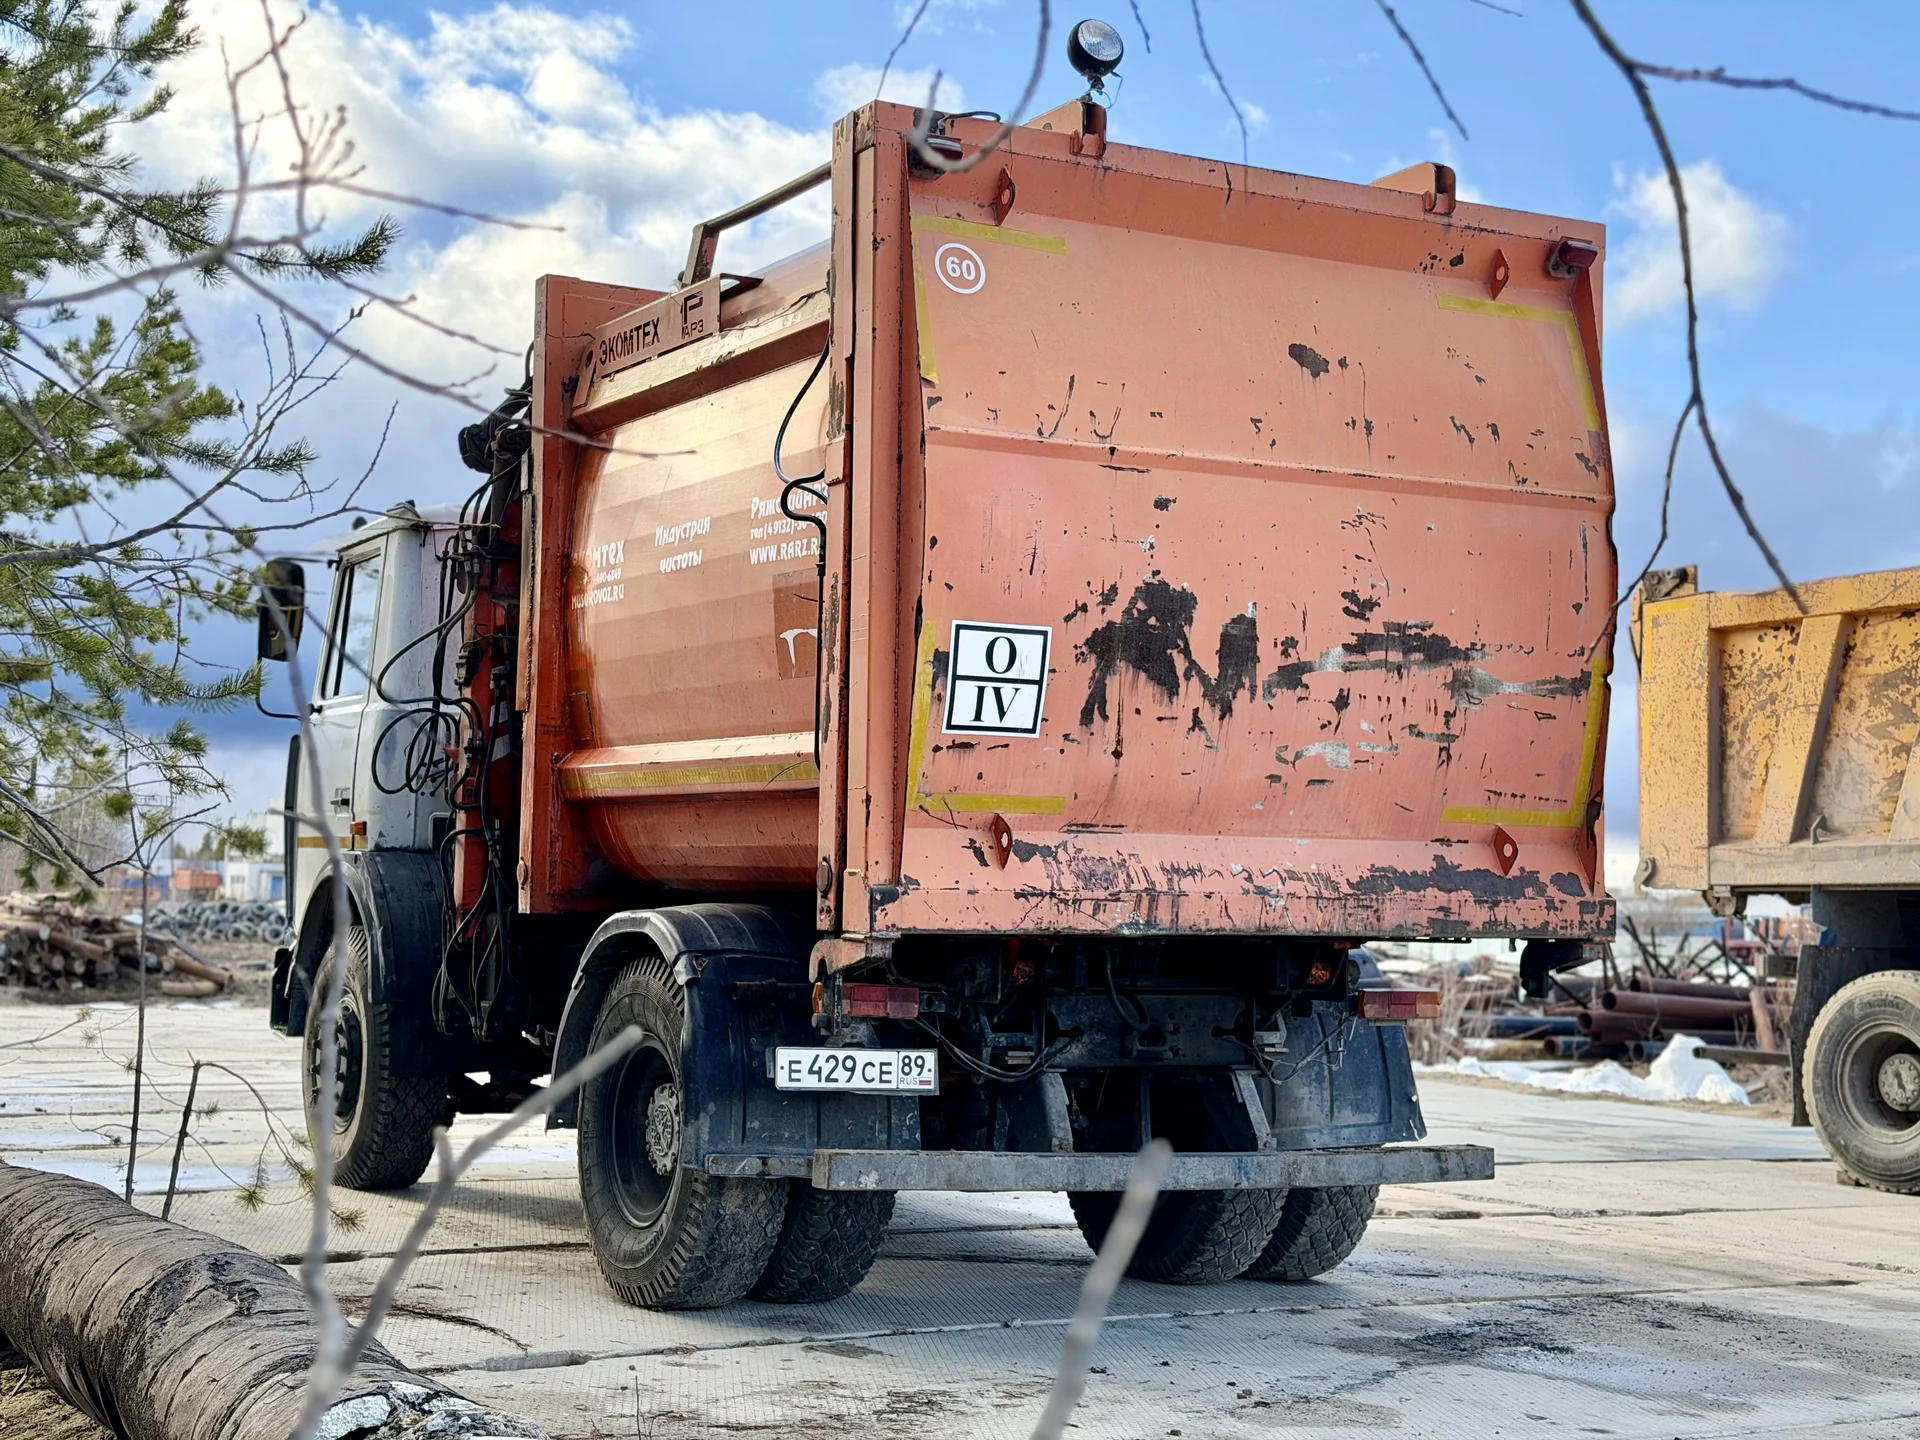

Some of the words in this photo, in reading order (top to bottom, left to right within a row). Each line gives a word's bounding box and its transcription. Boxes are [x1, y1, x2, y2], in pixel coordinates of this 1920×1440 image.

[946, 256, 976, 280] 60
[599, 317, 661, 367] ЭКОМТЕХ
[751, 490, 804, 520] Ряжсий
[655, 515, 711, 547] Индустрия
[659, 549, 703, 574] чистоты
[750, 537, 822, 565] WWW.RARZ.R
[985, 636, 1017, 674] O
[969, 685, 1021, 724] IV
[901, 1055, 925, 1077] 89
[900, 1076, 918, 1086] RUS
